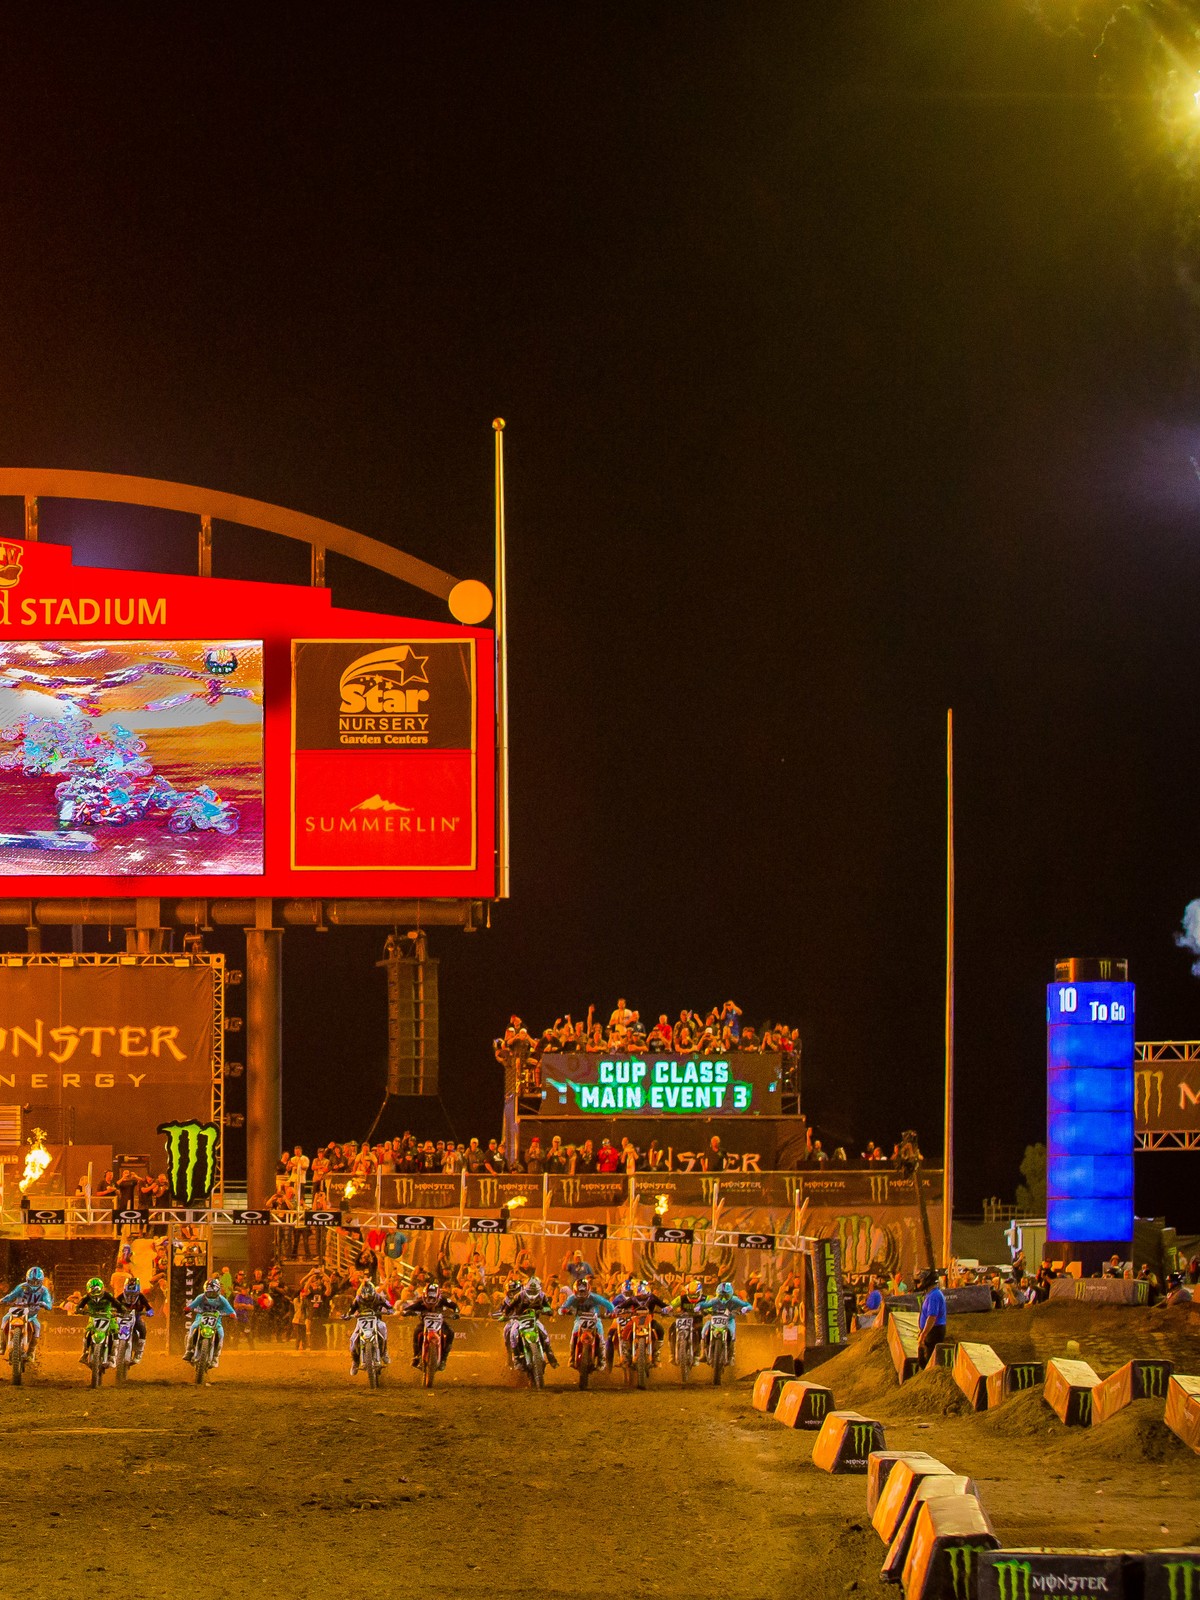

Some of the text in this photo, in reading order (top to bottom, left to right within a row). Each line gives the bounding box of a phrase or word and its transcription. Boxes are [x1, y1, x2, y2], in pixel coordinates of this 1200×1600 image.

[20, 598, 166, 625] STADIUM
[339, 683, 430, 713] Star
[339, 718, 429, 730] NURSERY
[340, 734, 429, 744] Garden Centers
[305, 816, 456, 832] SUMMERLIN
[1059, 987, 1077, 1012] 10
[1089, 1001, 1126, 1021] To Go
[600, 1062, 729, 1083] CUP CLASS
[581, 1086, 748, 1108] MAIN EVENT 3
[414, 1183, 455, 1191] MONSTER
[824, 1242, 841, 1343] LEADER
[93, 1319, 109, 1328] 17
[201, 1317, 218, 1326] 33
[361, 1319, 374, 1329] 21
[427, 1320, 441, 1329] 27
[524, 1320, 535, 1329] 3
[580, 1320, 596, 1329] 42
[845, 1458, 869, 1466] MONST
[1032, 1573, 1109, 1592] MONSTER
